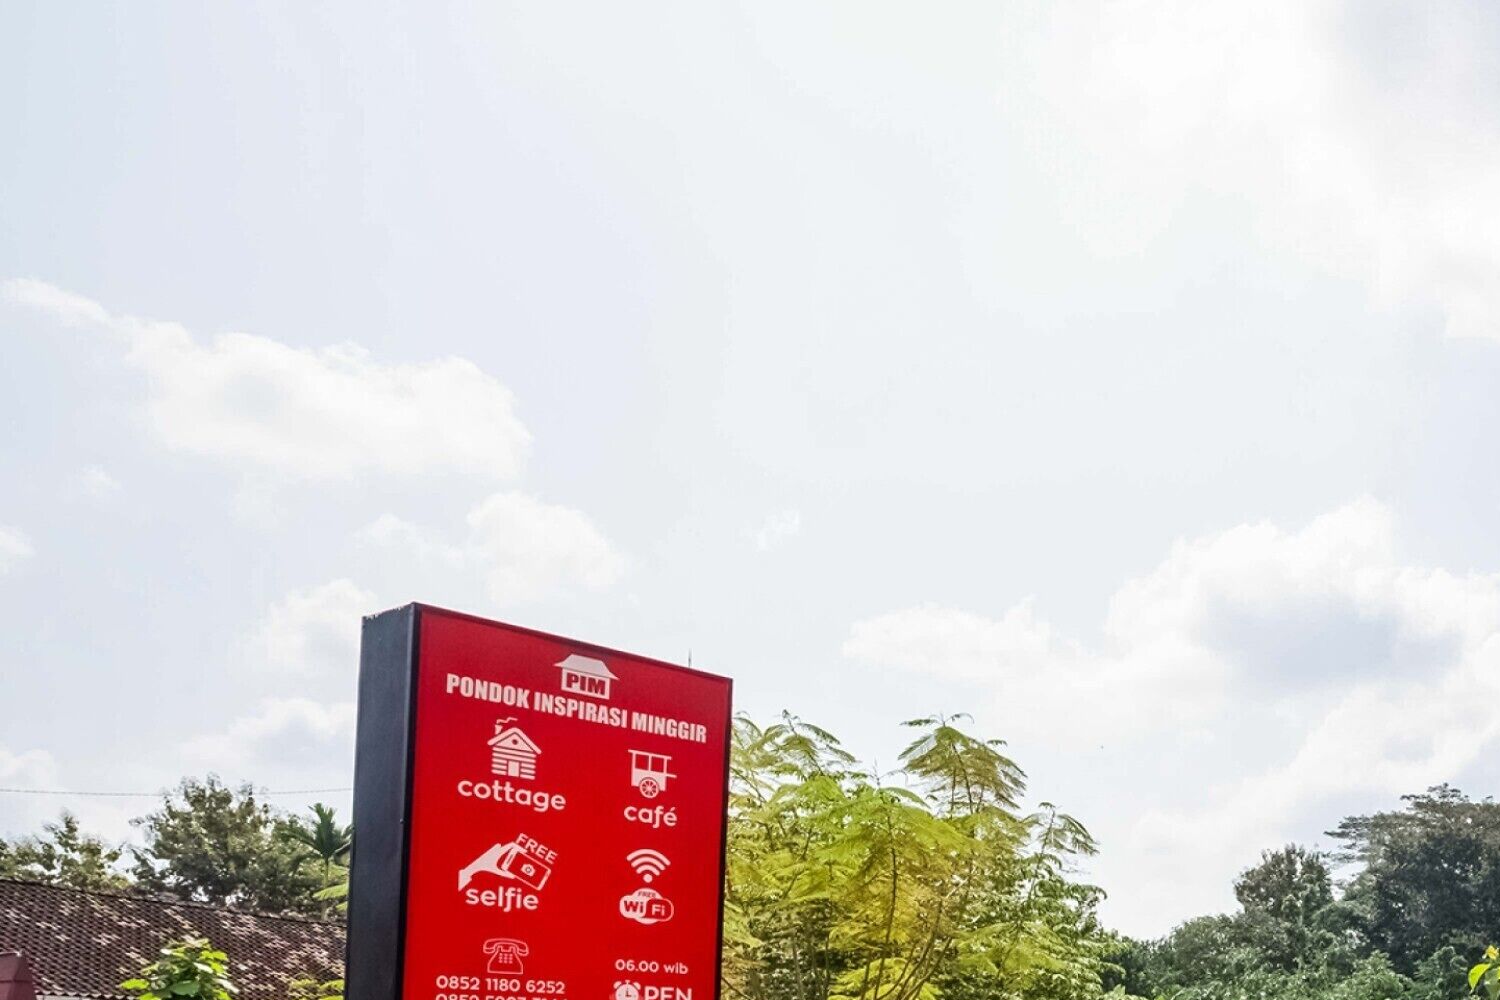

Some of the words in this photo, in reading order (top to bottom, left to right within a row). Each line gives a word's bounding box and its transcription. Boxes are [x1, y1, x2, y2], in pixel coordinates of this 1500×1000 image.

[566, 672, 606, 696] PIM
[446, 673, 530, 709] PONDOK
[534, 692, 628, 728] INSPIRASI
[632, 712, 707, 743] MINGGIR
[457, 779, 567, 812] cottage
[623, 805, 678, 829] café
[515, 833, 559, 865] FREE
[465, 886, 539, 912] selfie
[614, 959, 660, 973] 06.00
[663, 962, 689, 975] wib
[436, 975, 480, 990] 0852
[485, 977, 521, 992] 1180
[525, 980, 566, 995] 6252
